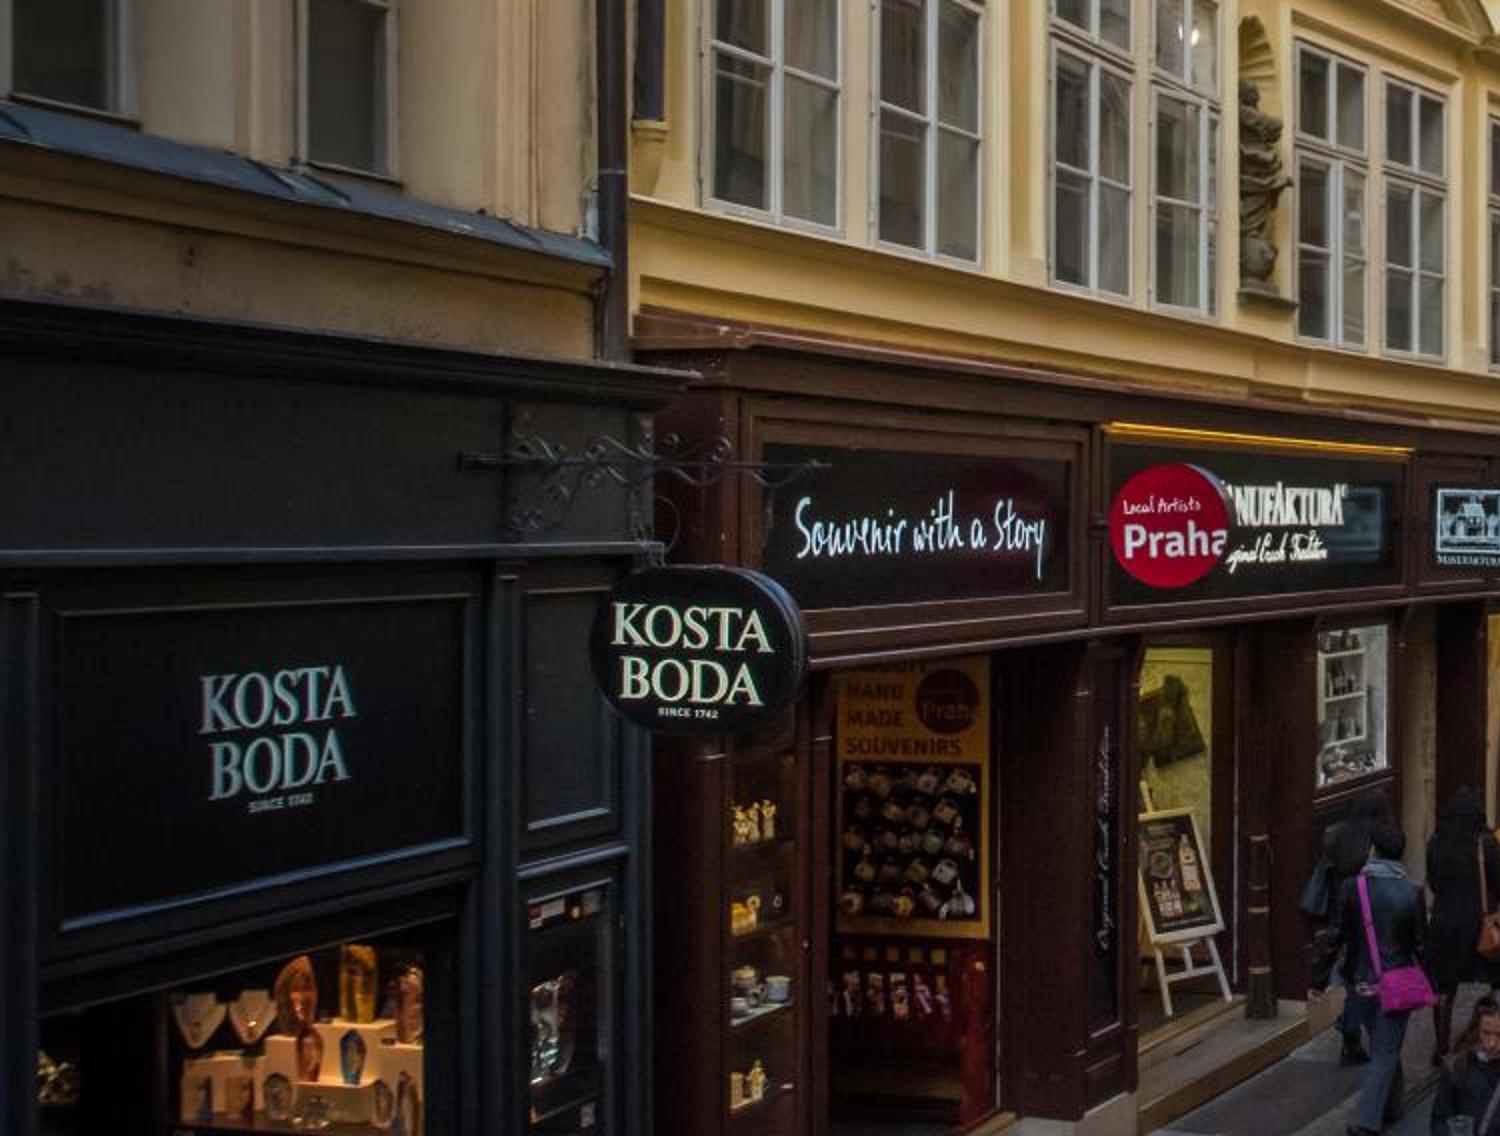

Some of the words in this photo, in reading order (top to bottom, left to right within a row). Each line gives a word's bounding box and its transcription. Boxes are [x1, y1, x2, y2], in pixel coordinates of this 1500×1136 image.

[1123, 495, 1155, 515] Local
[1157, 495, 1201, 513] Artists
[795, 496, 906, 559] Souvenir
[913, 489, 964, 553] with
[971, 518, 988, 550] a
[993, 497, 1046, 581] Story
[1123, 519, 1228, 560] Praha
[610, 601, 775, 654] KOSTA
[197, 663, 357, 735] KOSTA
[617, 655, 765, 707] BODA
[657, 706, 692, 718] SINCE
[694, 708, 720, 720] 1742
[848, 709, 904, 728] MADE
[207, 727, 353, 801] BODA
[846, 736, 962, 756] SOUVENIRS
